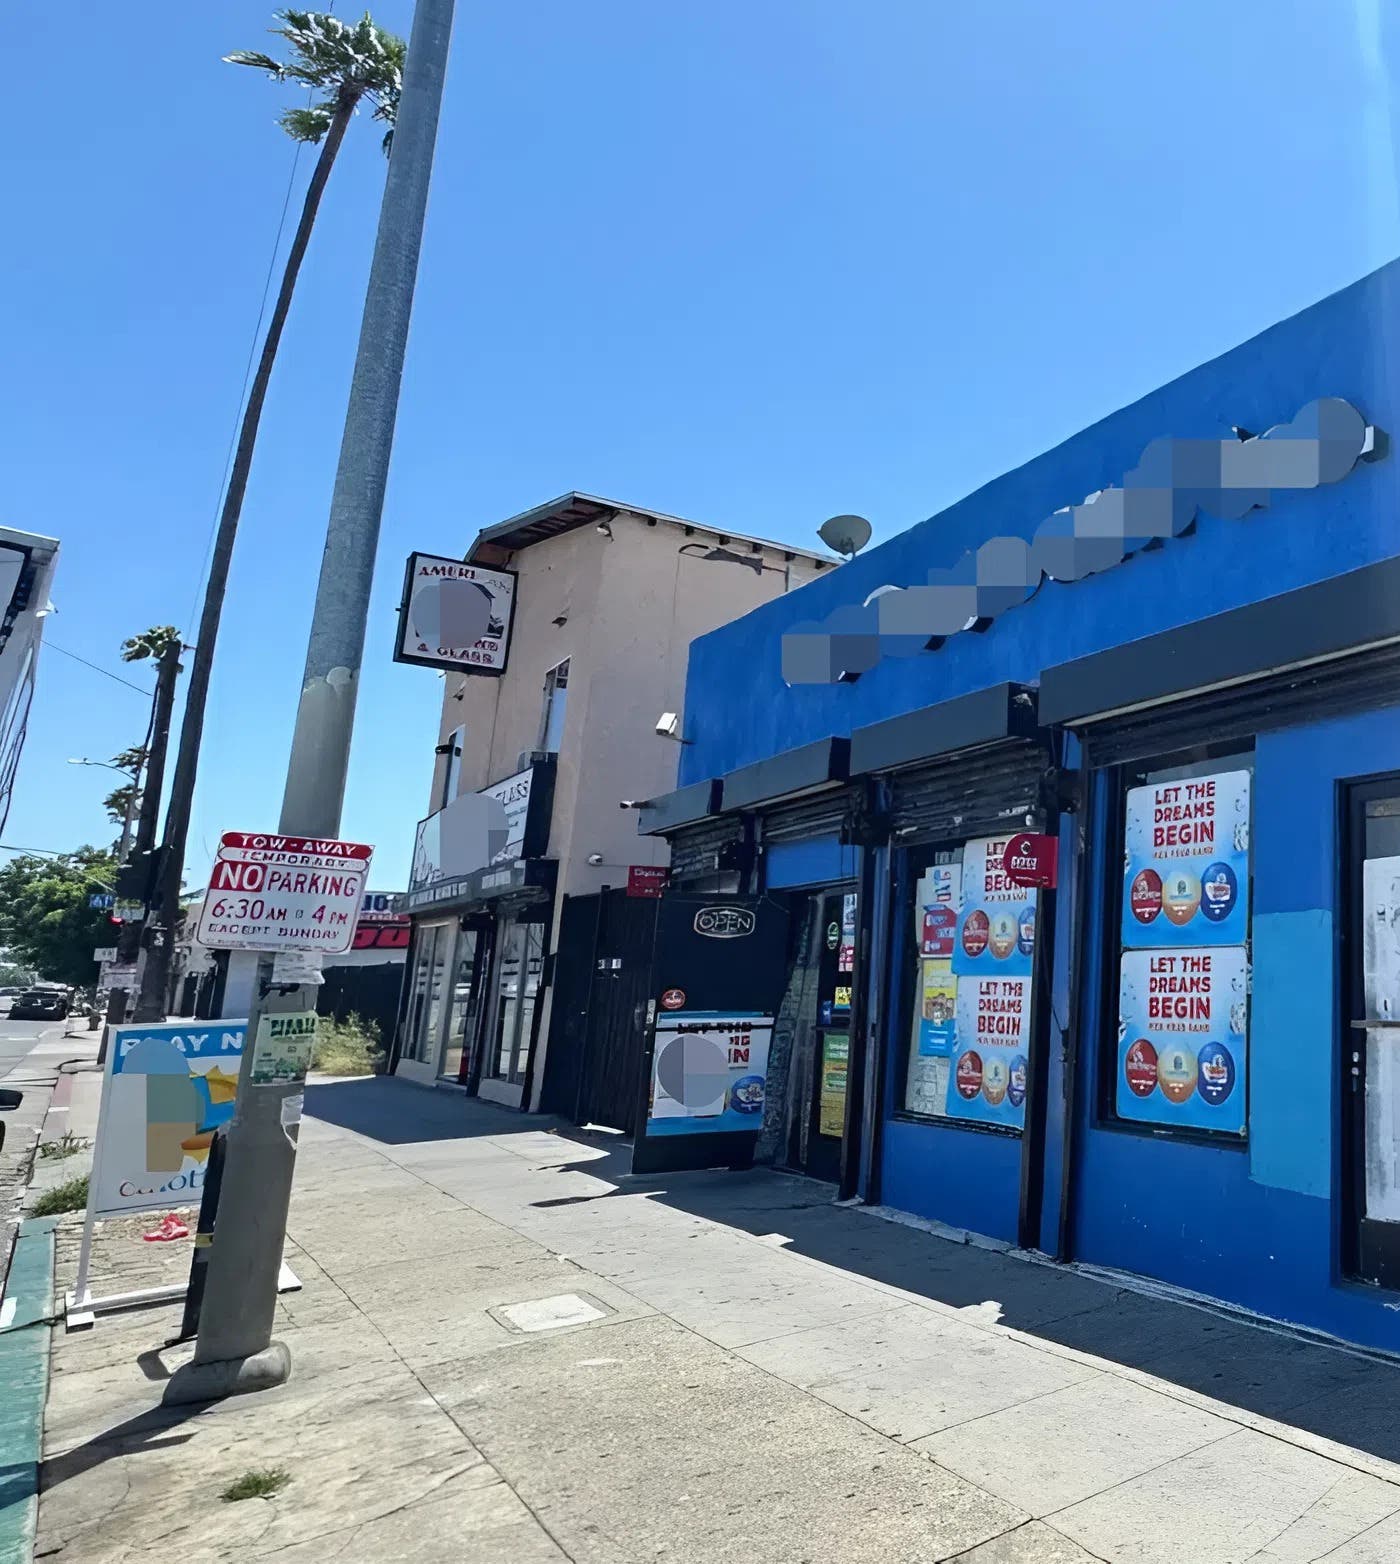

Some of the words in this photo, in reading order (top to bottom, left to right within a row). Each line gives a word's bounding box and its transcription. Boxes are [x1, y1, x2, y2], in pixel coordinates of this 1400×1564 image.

[1155, 787, 1181, 805] LET
[1185, 781, 1216, 800] THE
[1154, 801, 1215, 823] DREAMS
[1153, 820, 1214, 847] BEGIN
[218, 862, 264, 890] NO
[267, 871, 358, 897] PARKING
[212, 898, 265, 920] 6:30
[265, 908, 287, 921] AM
[312, 905, 326, 924] 4
[329, 911, 348, 925] PM
[699, 911, 751, 932] OPEN
[1150, 957, 1176, 973] LET
[1181, 956, 1211, 973] THE
[980, 982, 998, 996] LET
[1002, 982, 1023, 997] THE
[1149, 976, 1211, 993] DREAMS
[1148, 996, 1210, 1019] BEGIN
[977, 1015, 1021, 1036] BEGIN
